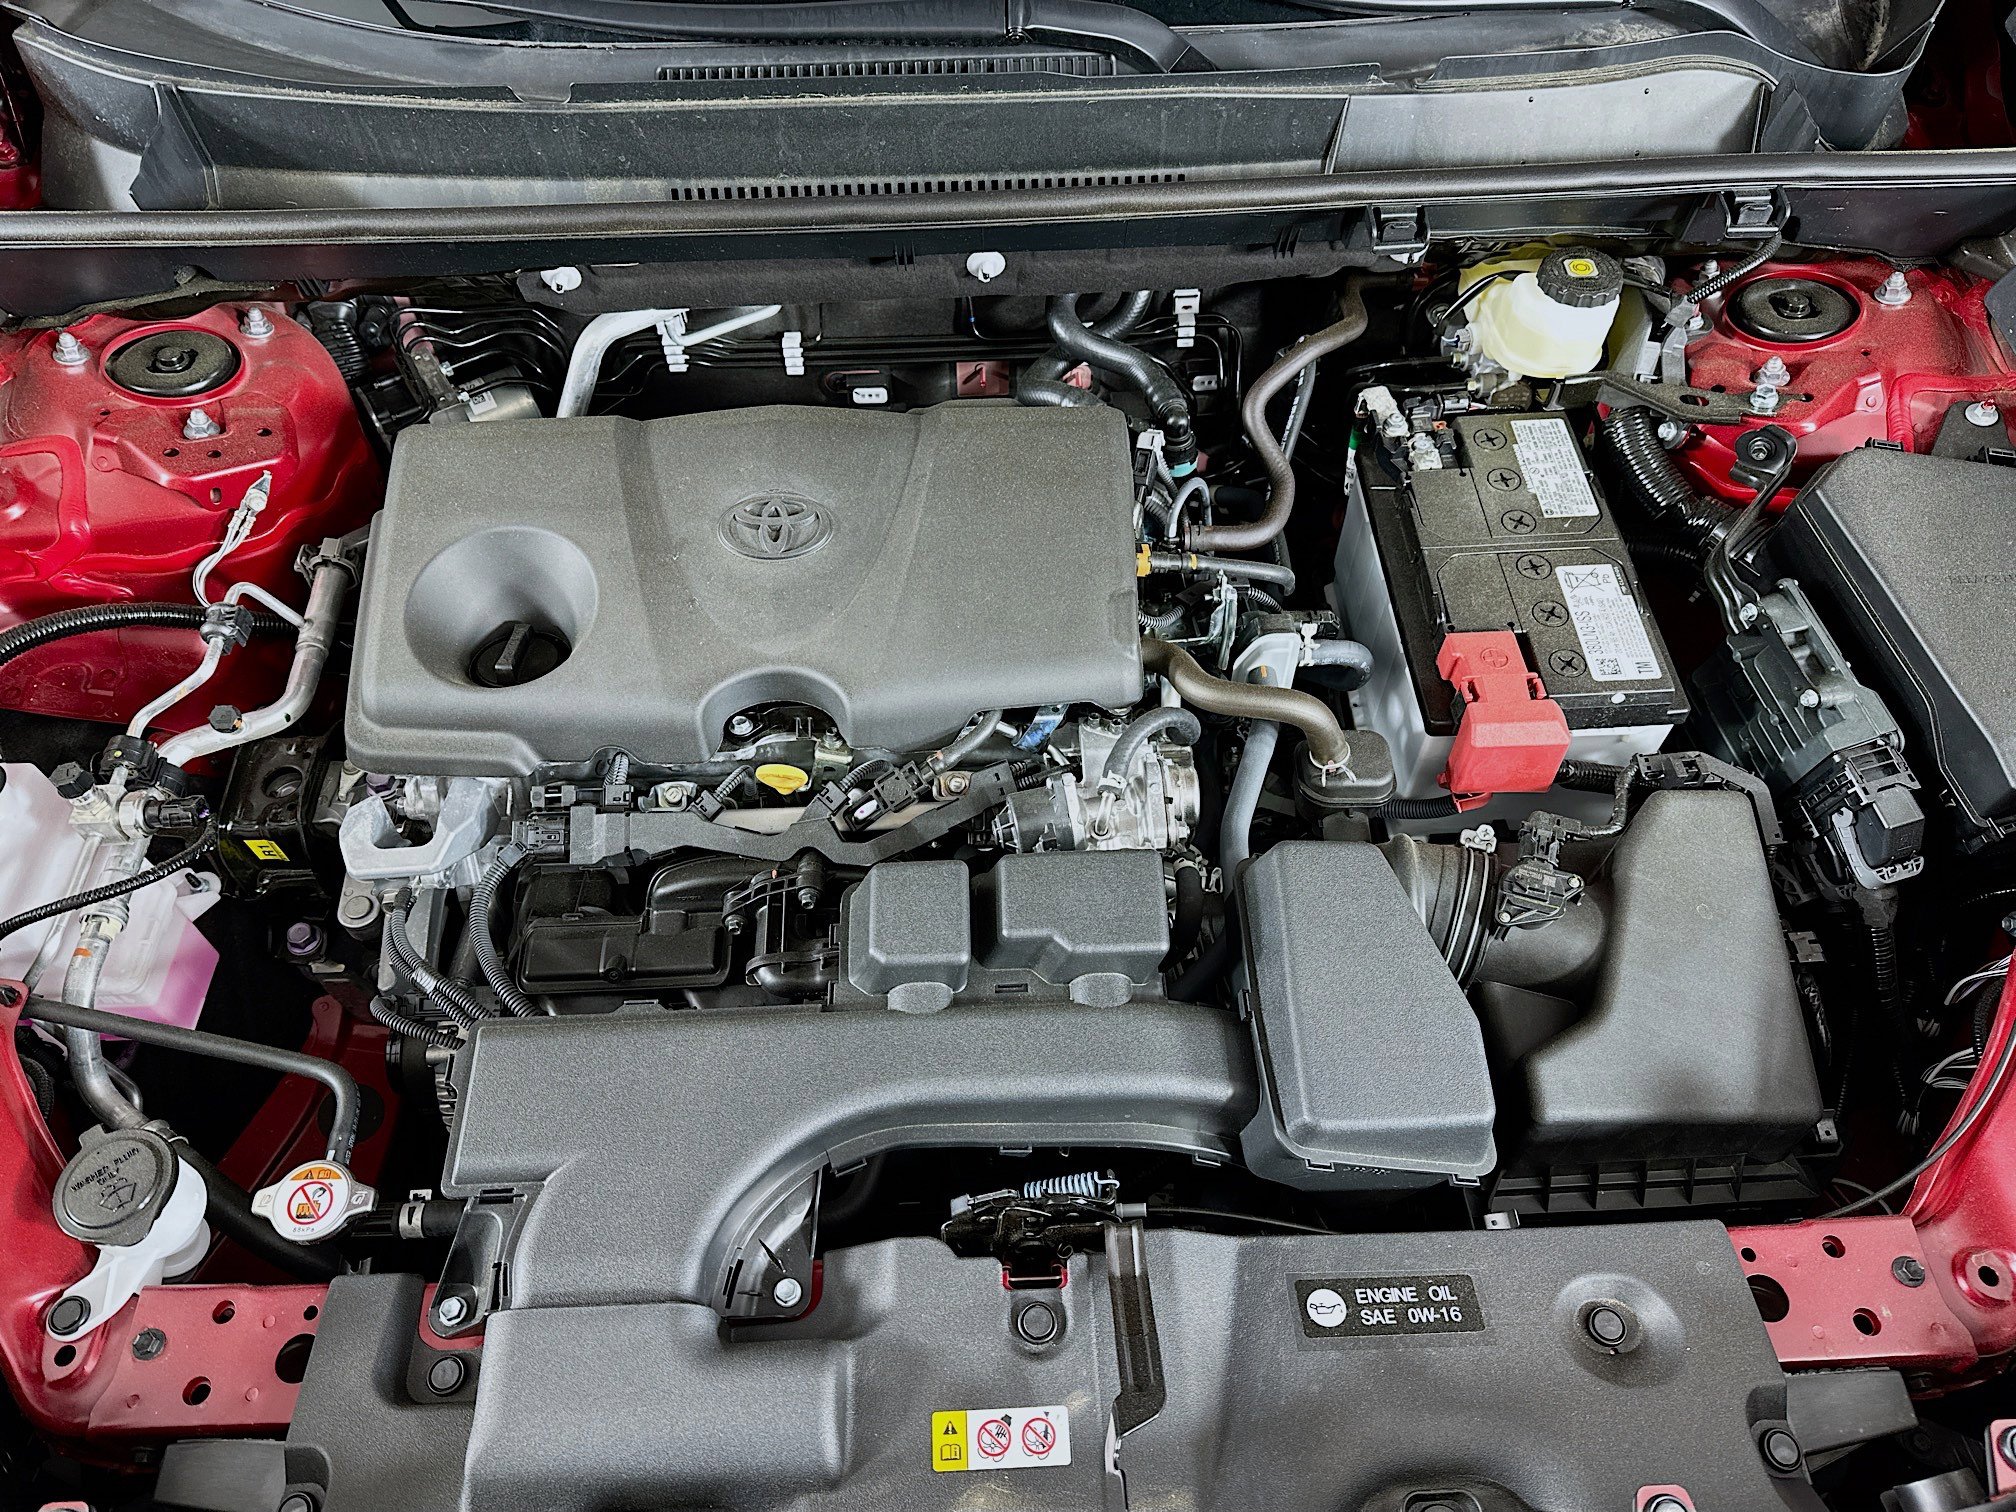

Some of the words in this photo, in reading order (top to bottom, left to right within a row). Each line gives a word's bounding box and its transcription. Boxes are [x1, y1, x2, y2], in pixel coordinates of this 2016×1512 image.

[1634, 661, 1654, 674] TM
[1354, 1286, 1419, 1304] ENGINE
[1428, 1285, 1458, 1301] OIL
[1360, 1308, 1397, 1326] SAE
[1408, 1306, 1463, 1324] 0W-16
